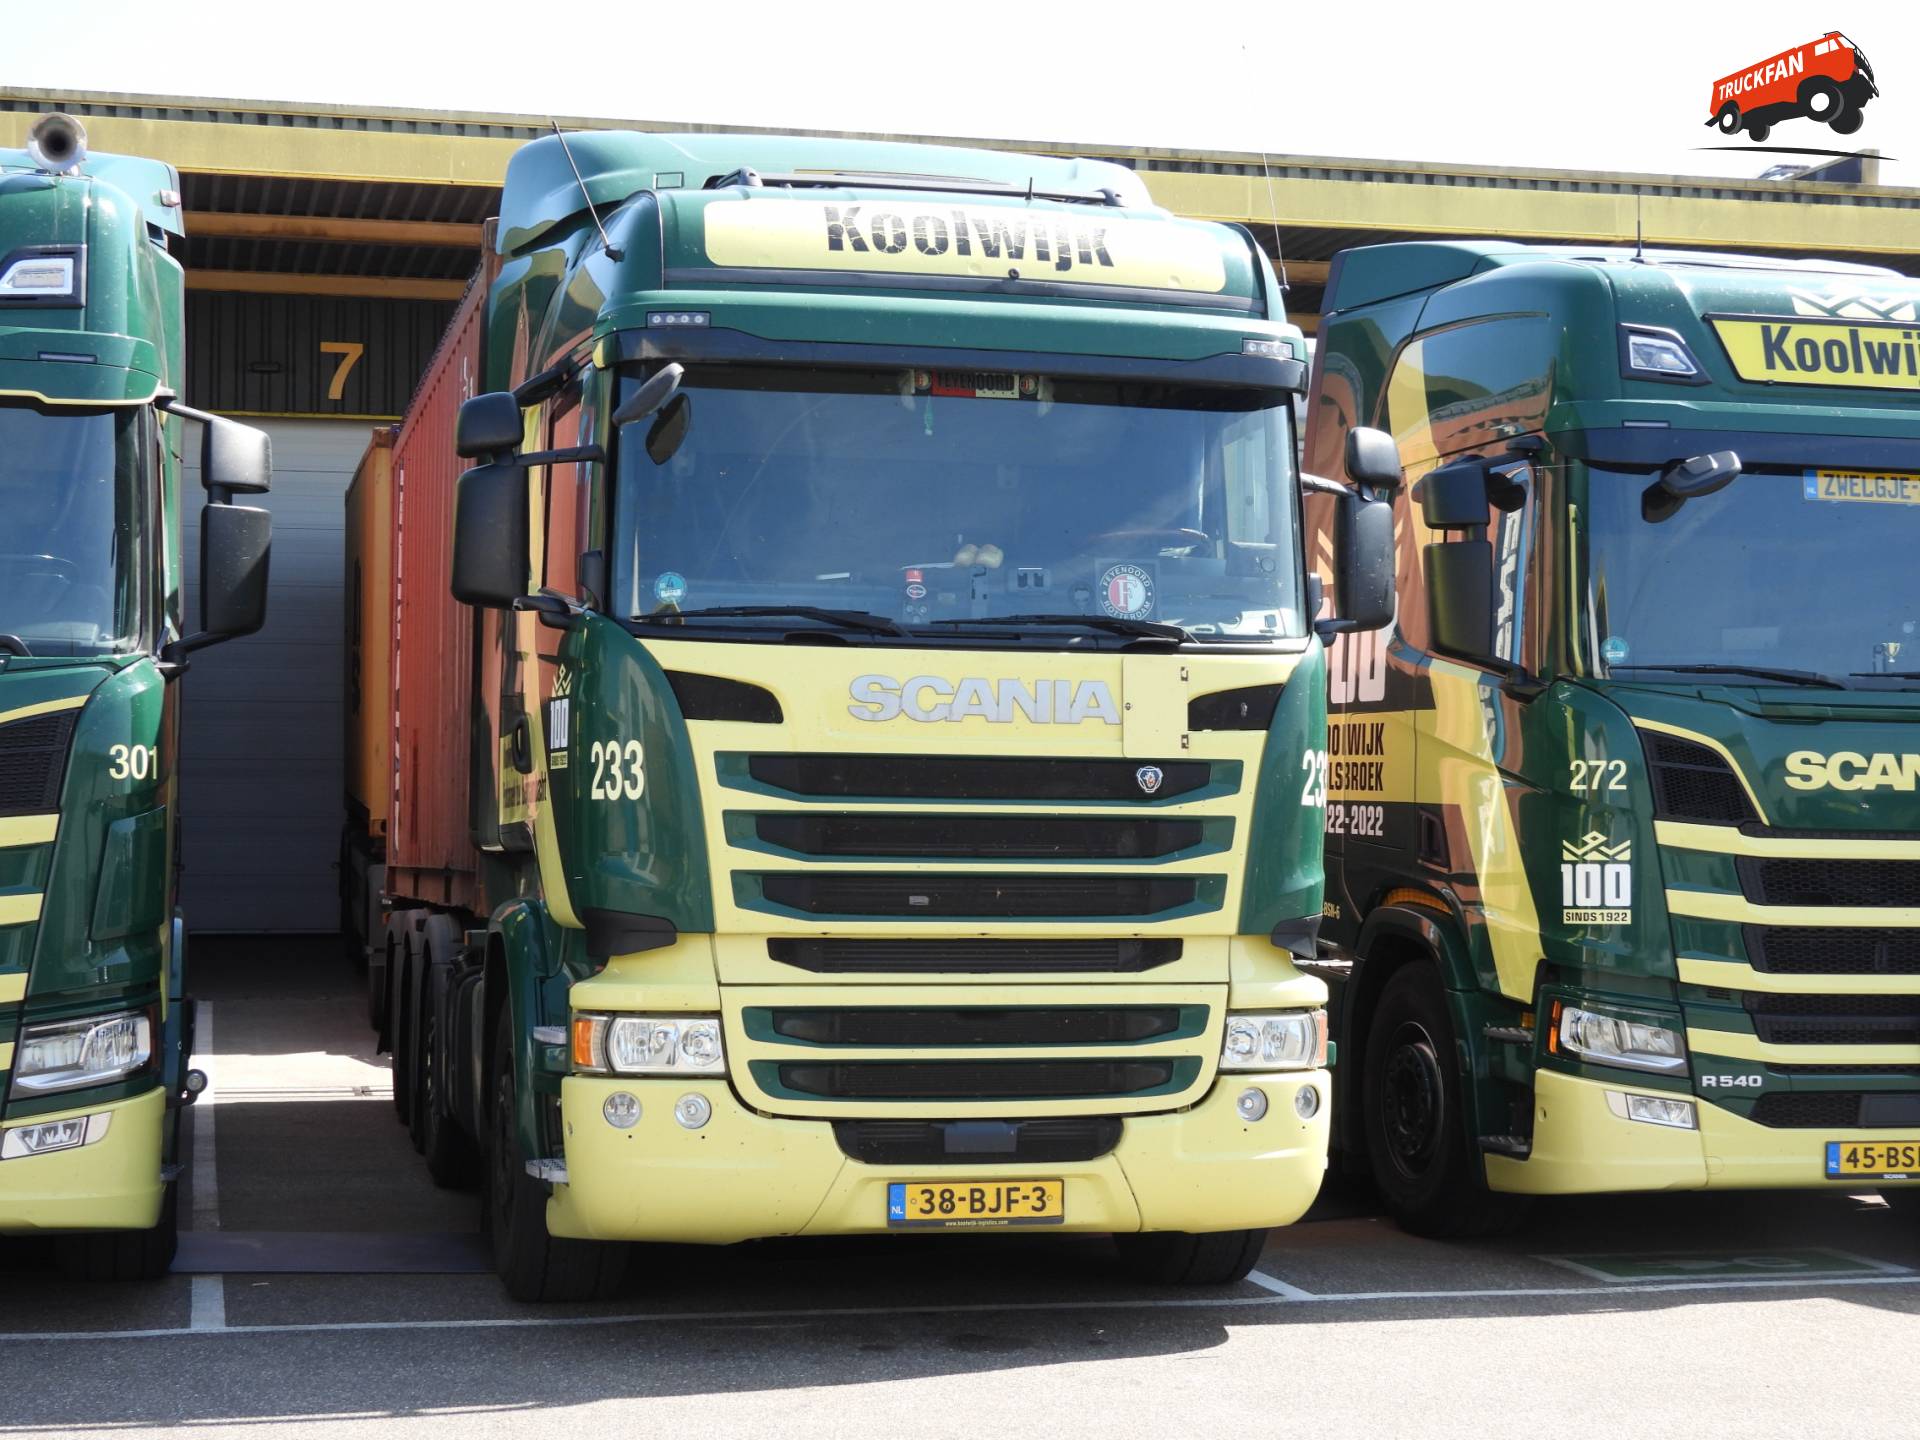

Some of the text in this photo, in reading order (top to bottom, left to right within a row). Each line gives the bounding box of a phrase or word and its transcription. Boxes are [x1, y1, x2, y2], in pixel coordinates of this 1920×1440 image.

[823, 206, 1115, 271] Koolwijk
[1760, 325, 1920, 376] Koolwi
[320, 341, 363, 400] 7
[1823, 473, 1920, 499] ZWELGJE-
[1103, 566, 1150, 587] FEYENOORD
[848, 674, 1122, 725] SCANIA
[109, 744, 157, 780] 301
[590, 739, 645, 801] 233
[1328, 761, 1384, 792] LSBROEK
[1569, 759, 1628, 791] 272
[1325, 804, 1384, 837] 22-2022
[1561, 863, 1632, 907] 100
[1565, 911, 1629, 922] SINDS 1922
[1846, 1146, 1920, 1168] 45-BS
[891, 1206, 904, 1214] NL
[919, 1186, 1047, 1215] 38-BJF-3
